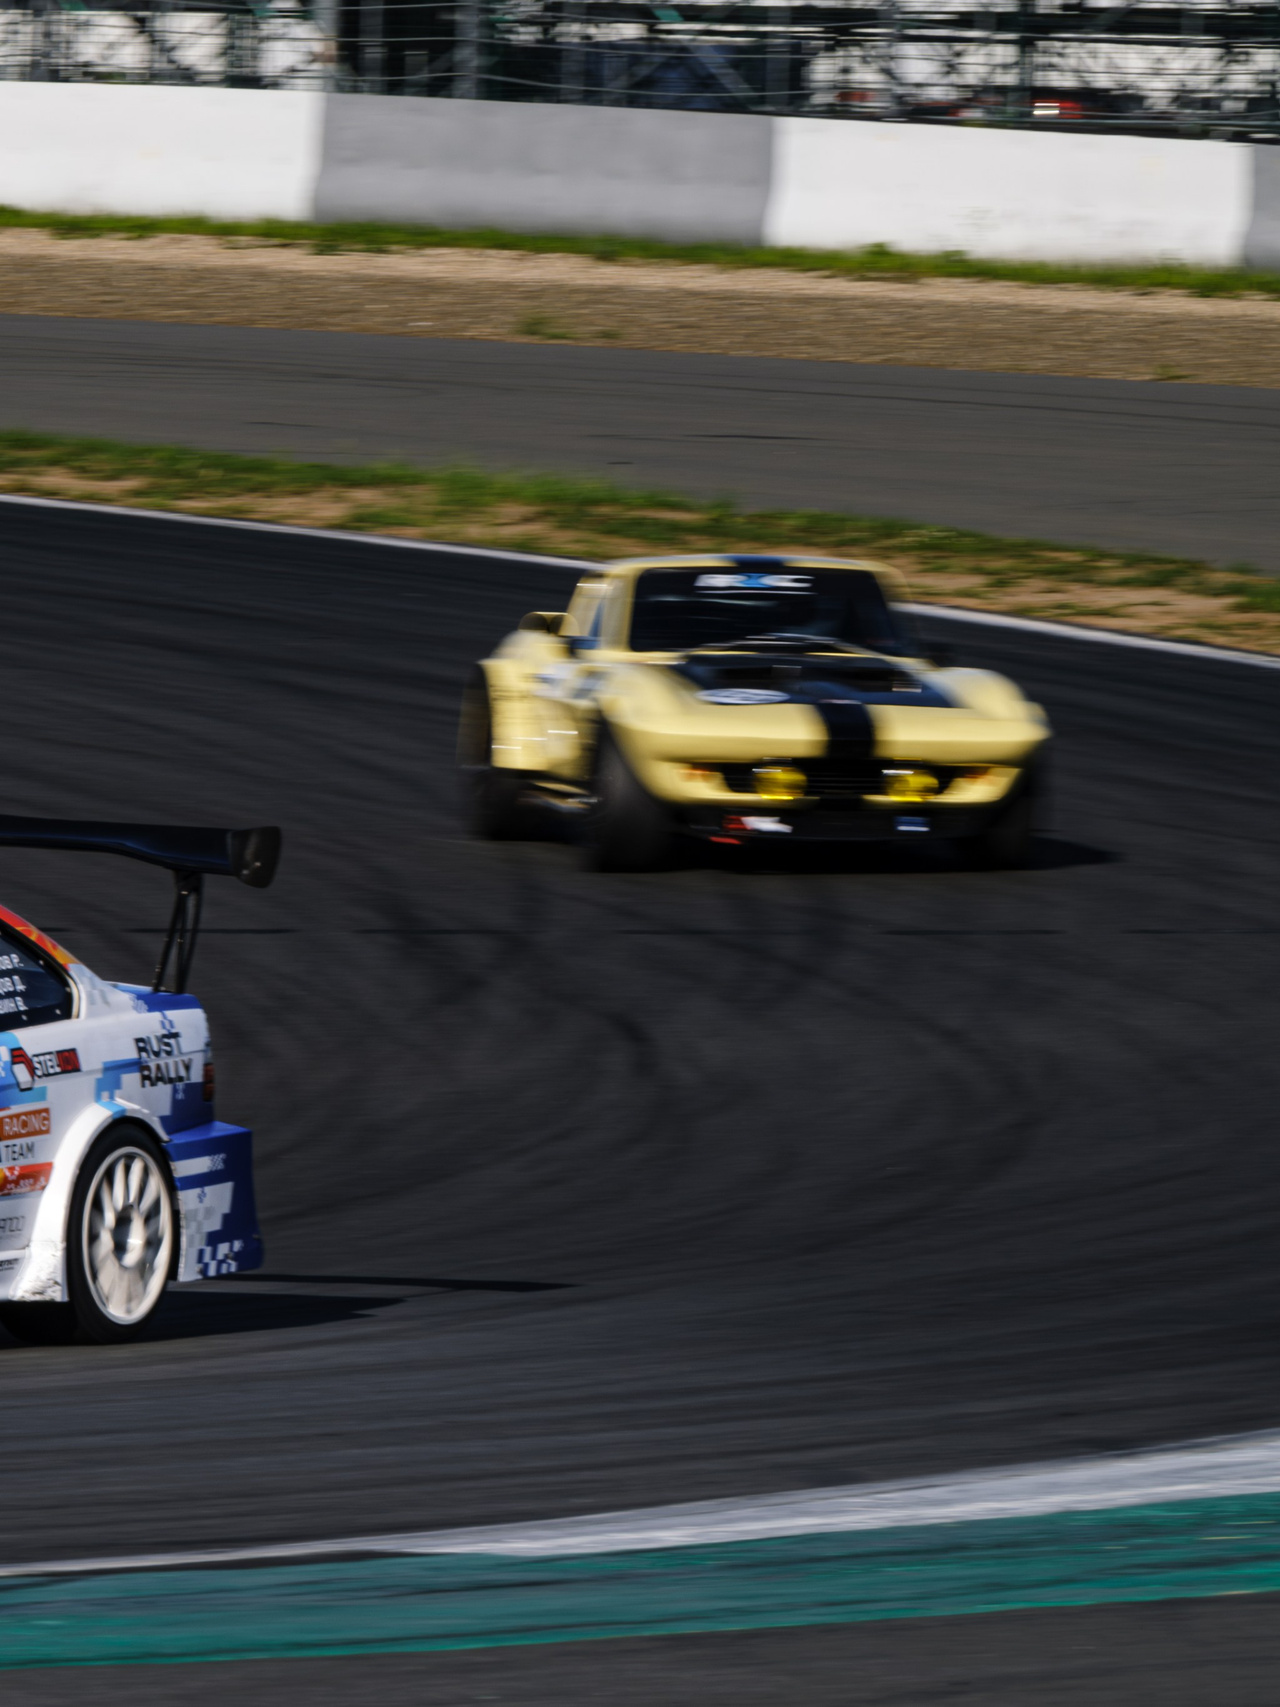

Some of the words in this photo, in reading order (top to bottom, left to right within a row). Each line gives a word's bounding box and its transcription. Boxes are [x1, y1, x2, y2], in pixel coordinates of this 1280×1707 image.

[133, 1032, 182, 1060] RUST
[32, 1048, 81, 1078] STELKON
[139, 1058, 193, 1088] RALLY
[3, 1113, 50, 1136] RACING
[4, 1142, 35, 1162] TEAM
